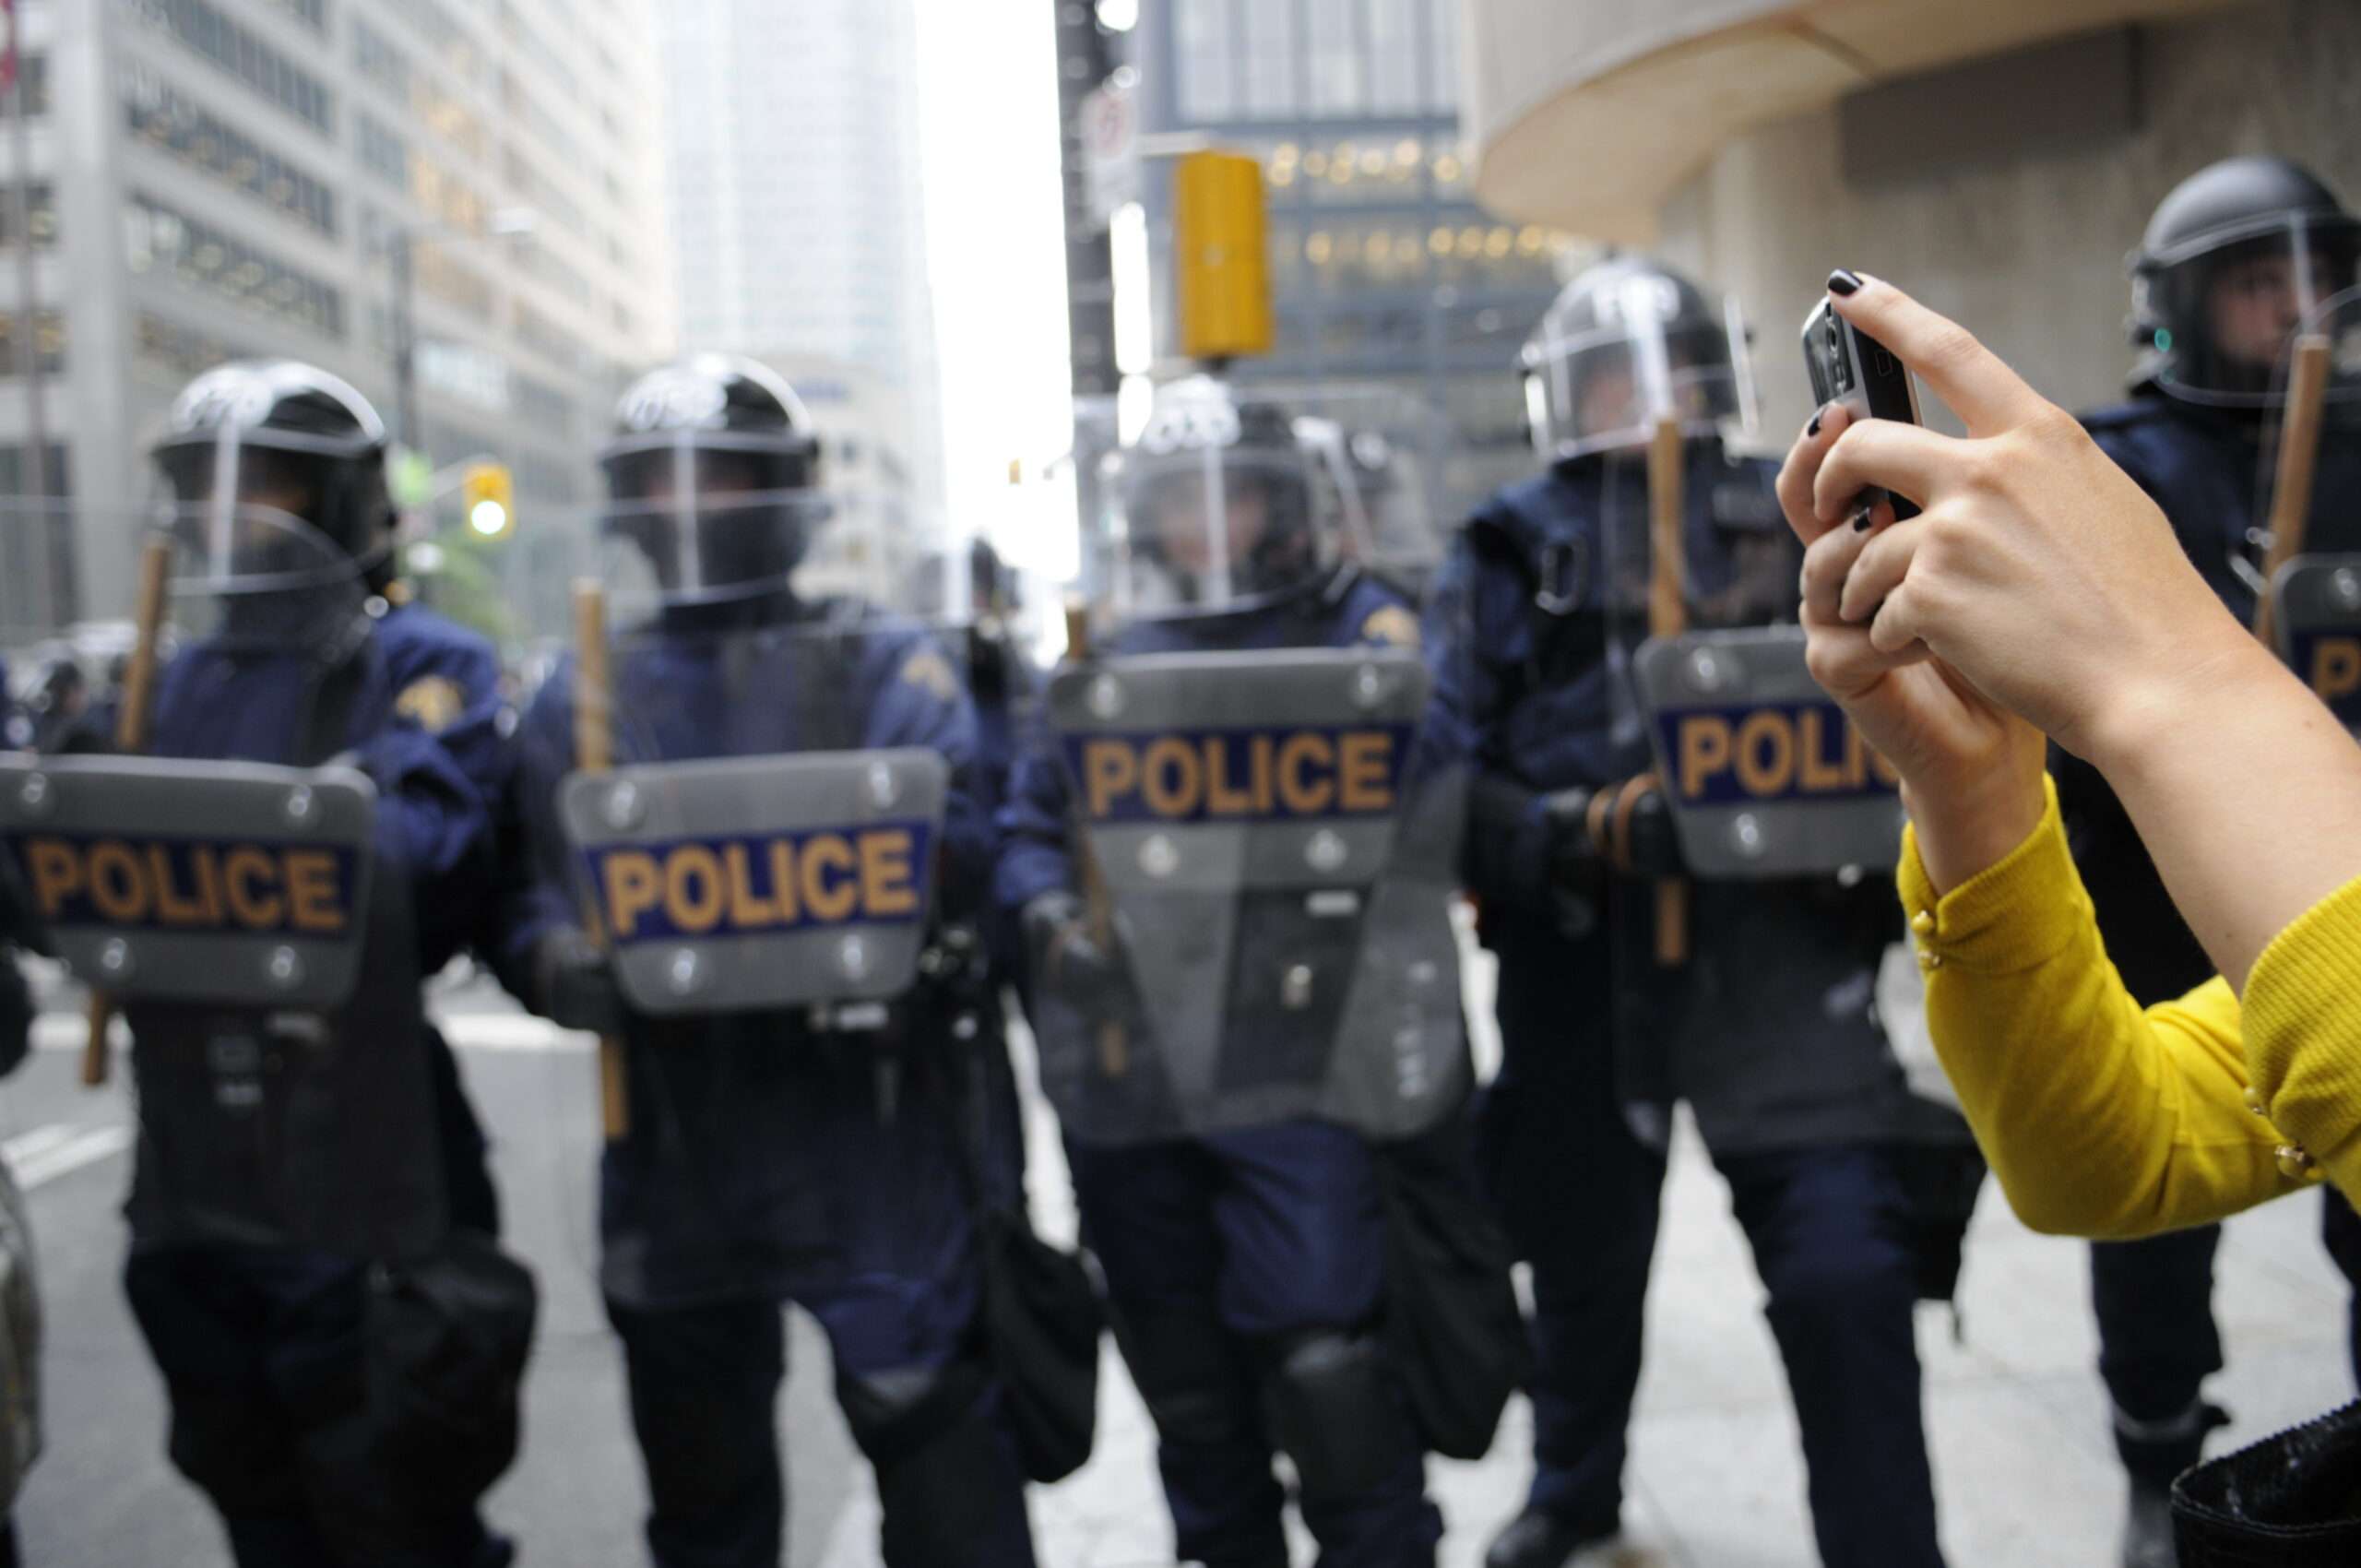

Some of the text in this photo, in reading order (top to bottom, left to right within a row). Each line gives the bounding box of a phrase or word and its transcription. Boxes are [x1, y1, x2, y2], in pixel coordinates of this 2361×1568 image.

[1085, 732, 1394, 816] POLICE
[1679, 709, 1899, 799] POLI
[29, 840, 342, 928] POLICE
[603, 832, 918, 935] POLICE
